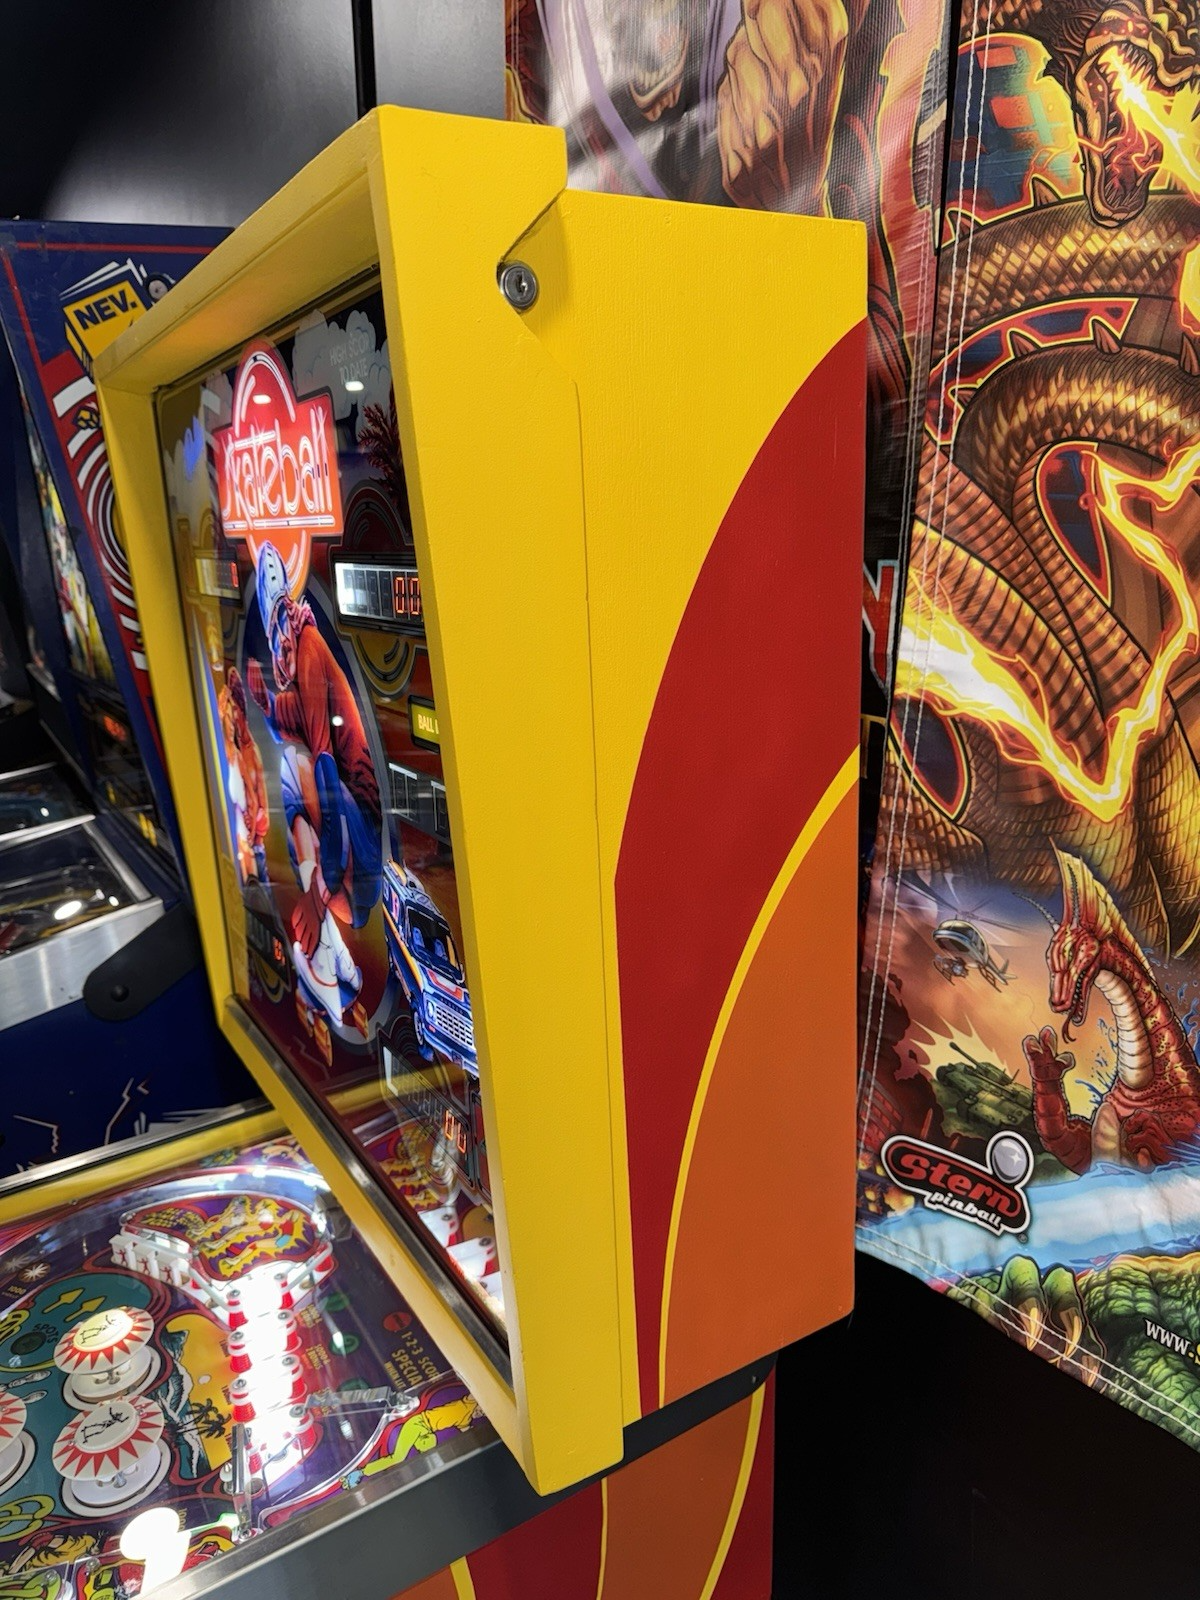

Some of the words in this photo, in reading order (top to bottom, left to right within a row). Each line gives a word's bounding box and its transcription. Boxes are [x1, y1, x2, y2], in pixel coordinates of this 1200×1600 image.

[417, 713, 435, 733] BALL
[899, 1153, 1013, 1210] Stern
[929, 1191, 1002, 1227] pinball
[34, 1323, 59, 1343] SPOTS
